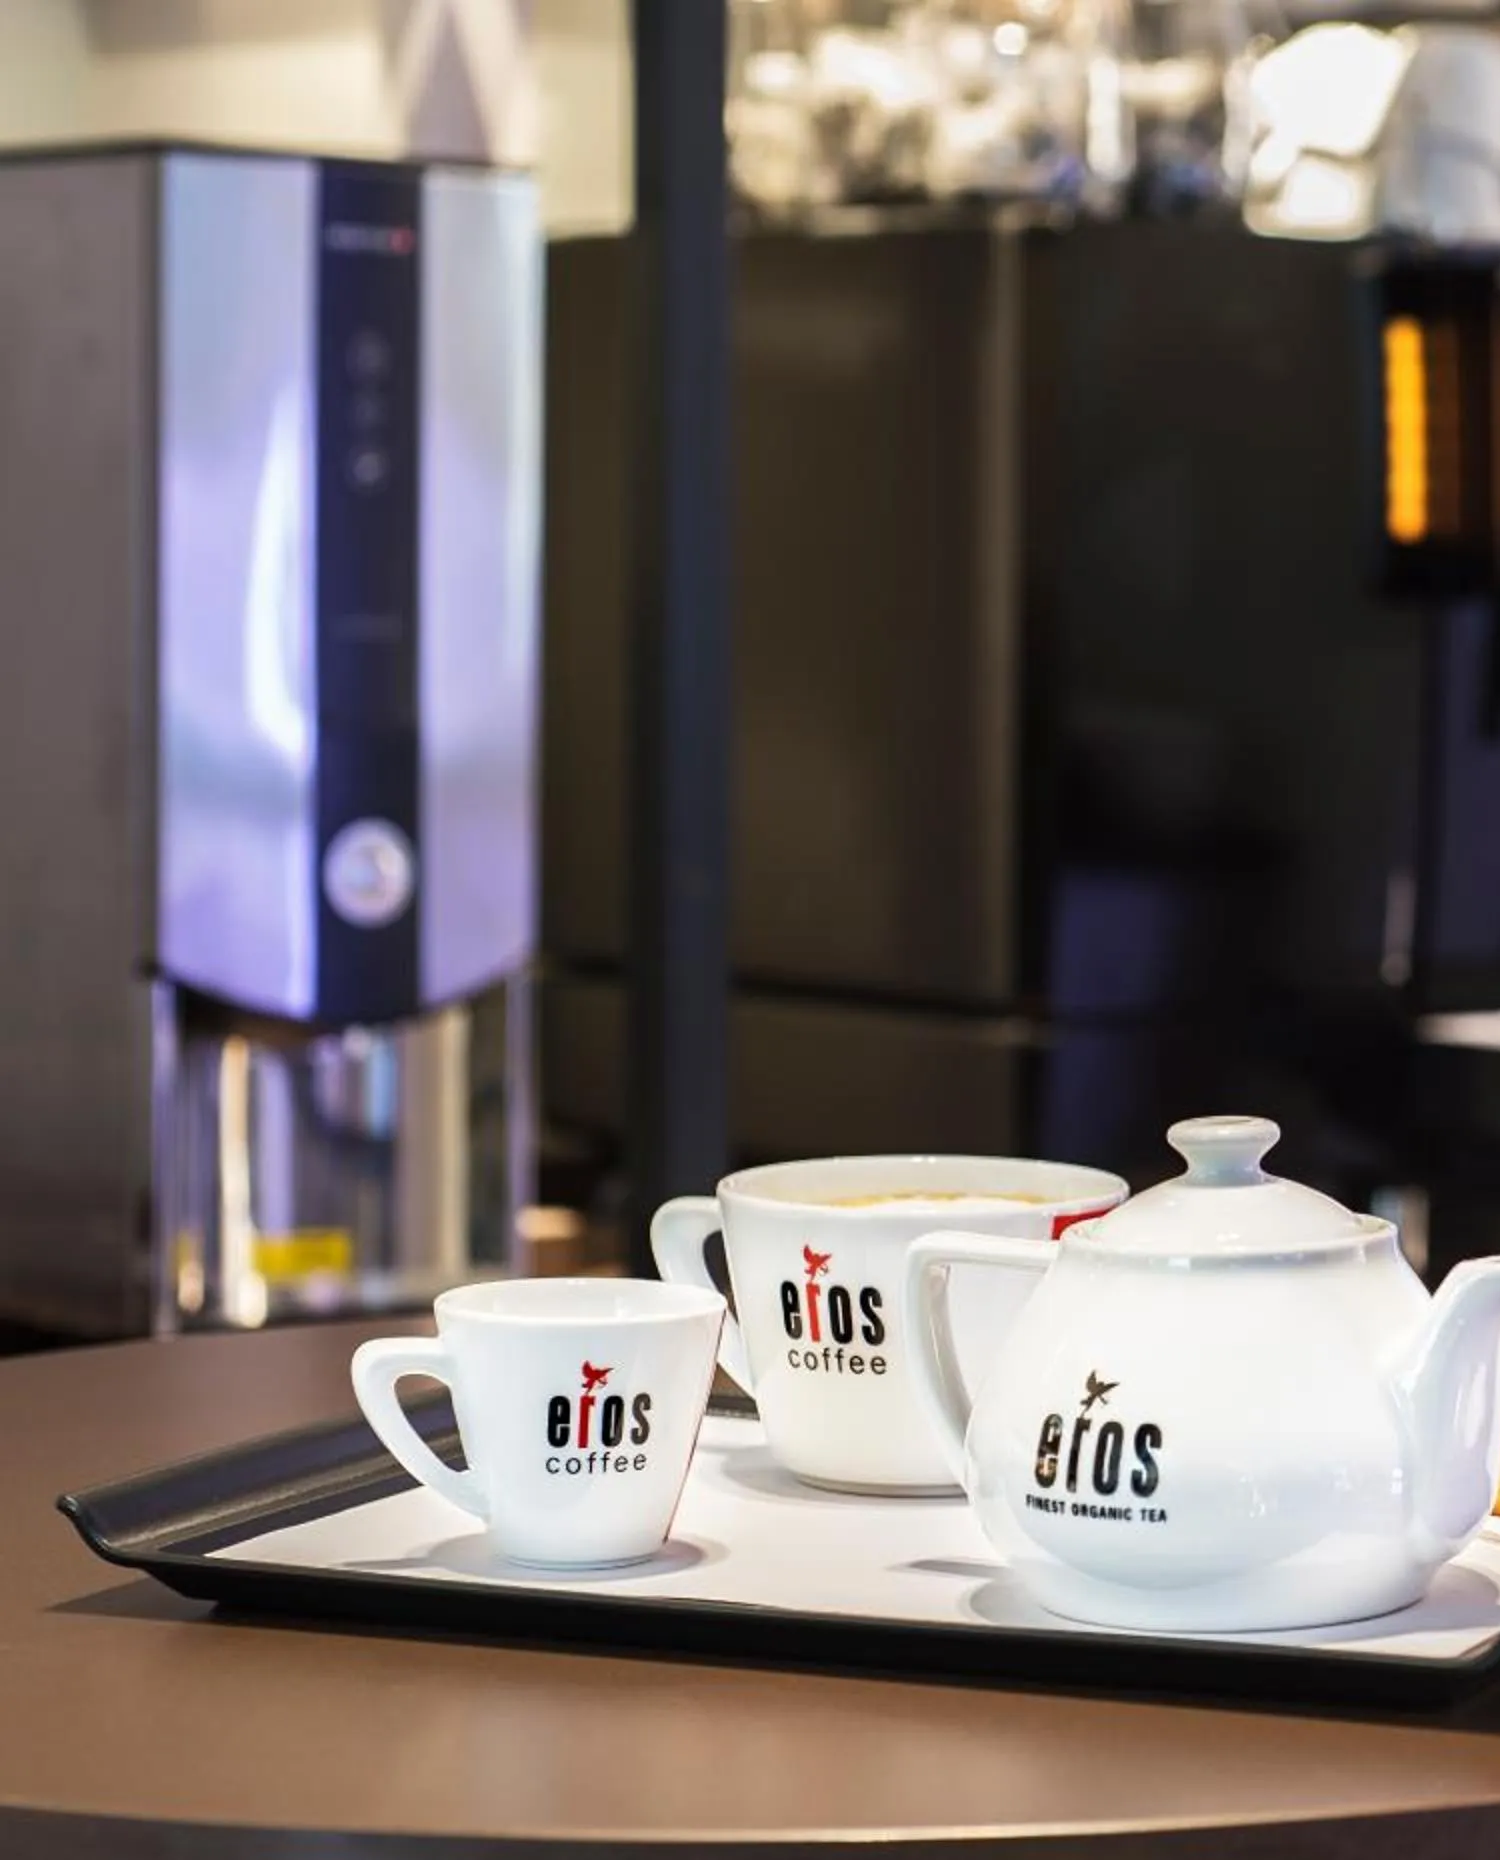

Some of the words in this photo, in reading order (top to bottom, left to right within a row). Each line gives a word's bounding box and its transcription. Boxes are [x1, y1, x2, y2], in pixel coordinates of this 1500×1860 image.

[780, 1280, 885, 1346] eros
[787, 1347, 887, 1375] coffee
[547, 1393, 652, 1448] eros
[545, 1451, 648, 1474] coffee
[1034, 1413, 1163, 1498] eros
[1025, 1494, 1066, 1513] FINEST
[1071, 1503, 1133, 1521] ORGANIC
[1140, 1508, 1167, 1522] TEA
